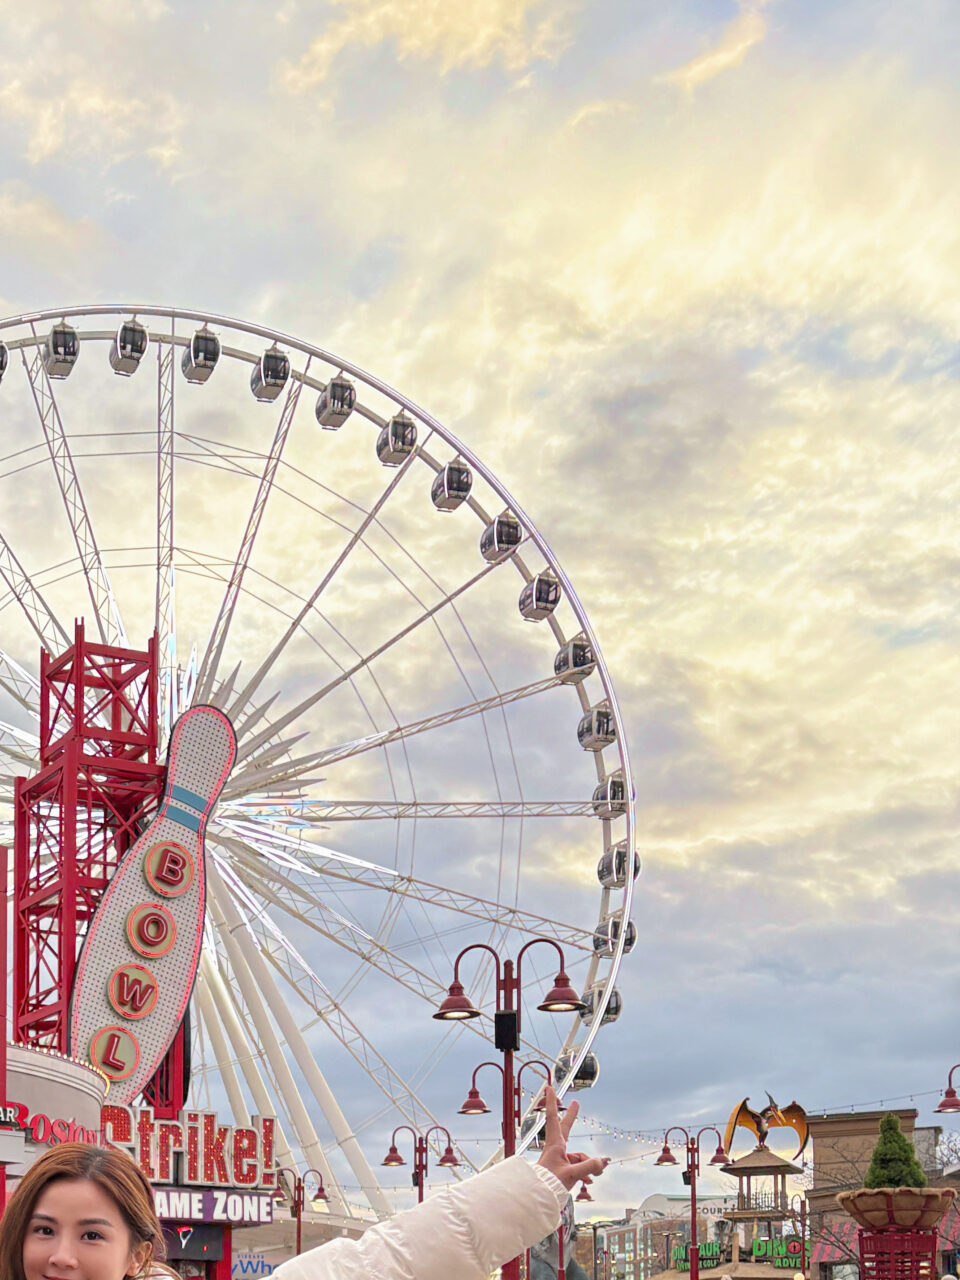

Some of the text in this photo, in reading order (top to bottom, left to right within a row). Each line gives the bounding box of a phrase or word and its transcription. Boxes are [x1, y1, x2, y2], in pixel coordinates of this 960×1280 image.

[101, 1103, 277, 1189] Strike!
[154, 1191, 272, 1222] AME ZONE
